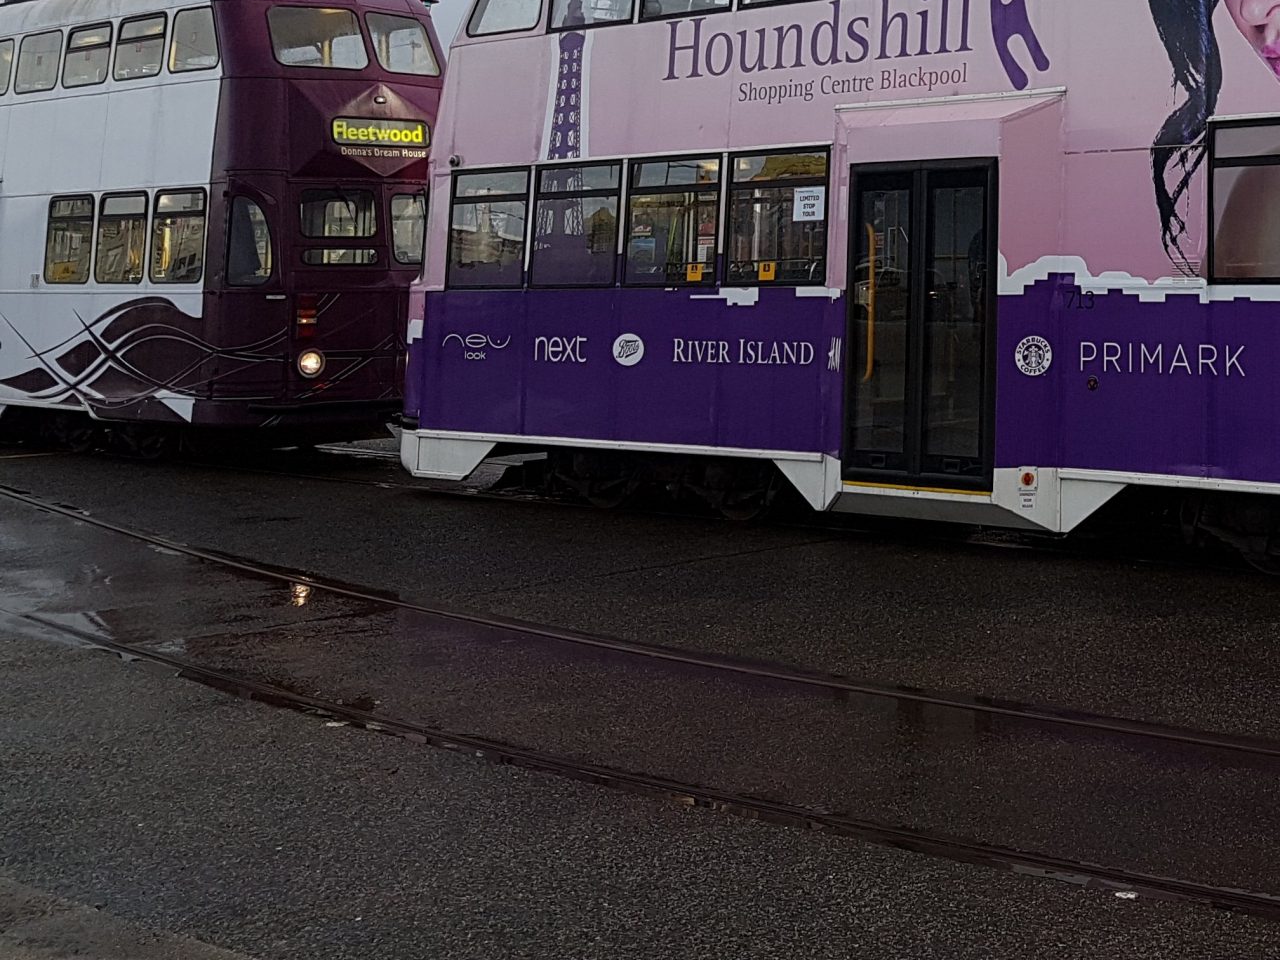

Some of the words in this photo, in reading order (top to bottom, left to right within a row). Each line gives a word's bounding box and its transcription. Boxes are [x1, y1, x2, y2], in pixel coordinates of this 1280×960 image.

[737, 78, 815, 105] Shopping
[820, 74, 875, 96] Centre
[879, 62, 968, 91] Blackpool
[332, 120, 423, 143] Fleetwood
[341, 146, 372, 156] Donna's
[374, 148, 400, 157] Dream
[402, 149, 427, 158] House
[1064, 290, 1096, 310] 713
[442, 333, 511, 349] new
[534, 335, 588, 363] next
[1016, 337, 1051, 355] STARBUCKS
[464, 350, 487, 360] look
[672, 338, 731, 363] RIVER
[738, 338, 815, 365] ISLAND
[1079, 342, 1246, 377] PRIMARK
[1020, 363, 1047, 375] COFFEE
